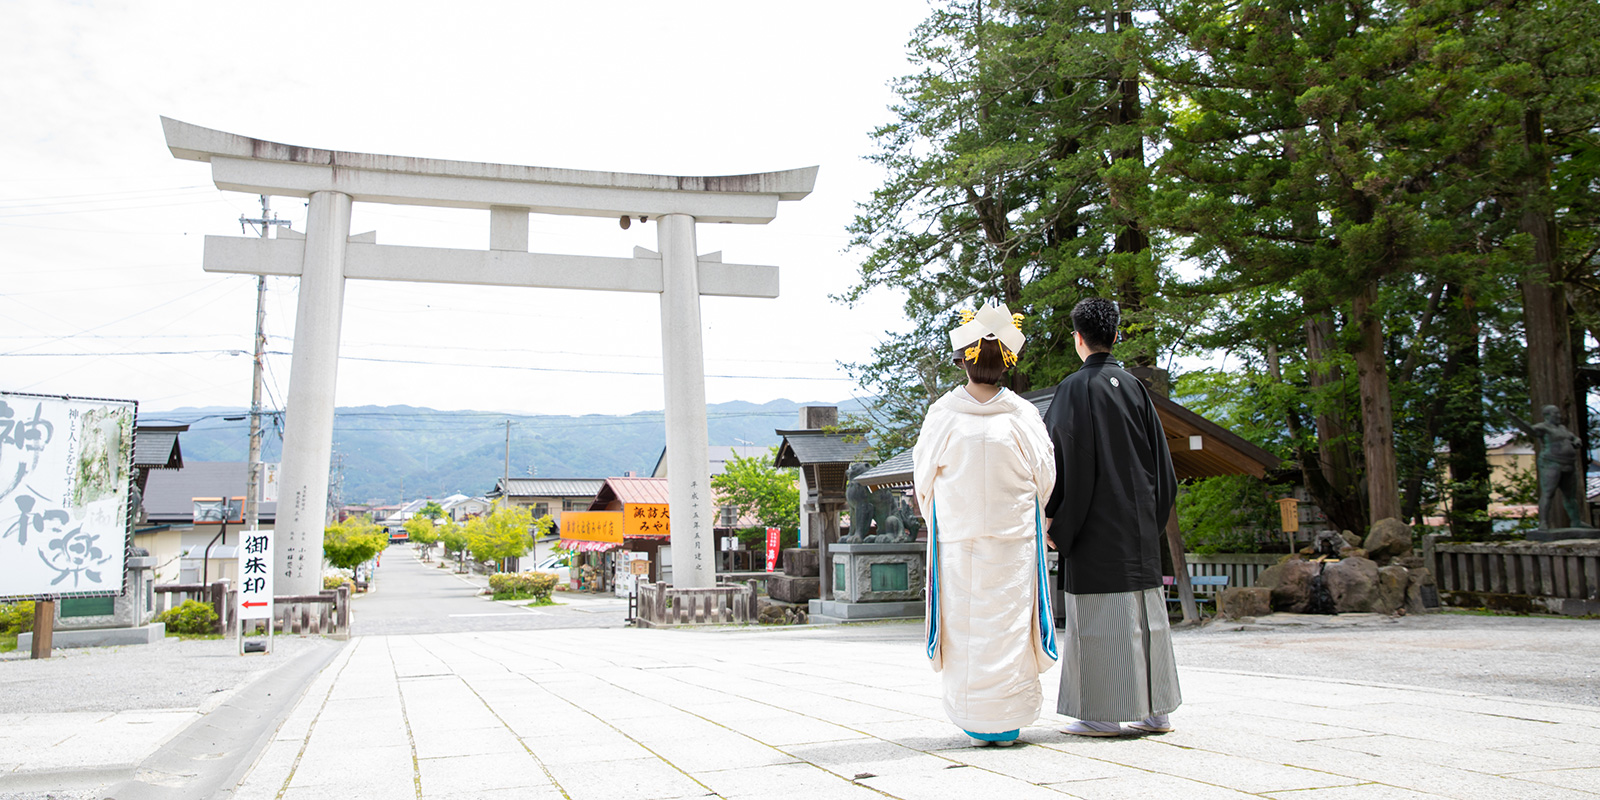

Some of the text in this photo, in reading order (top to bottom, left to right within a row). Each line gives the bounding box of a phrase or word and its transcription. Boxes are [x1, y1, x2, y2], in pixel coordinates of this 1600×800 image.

[62, 408, 80, 509] 神と人とをむすぶ柱
[633, 506, 670, 519] 諏訪大
[690, 480, 703, 571] 平成十五年五月建之
[243, 535, 269, 594] 御朱印
